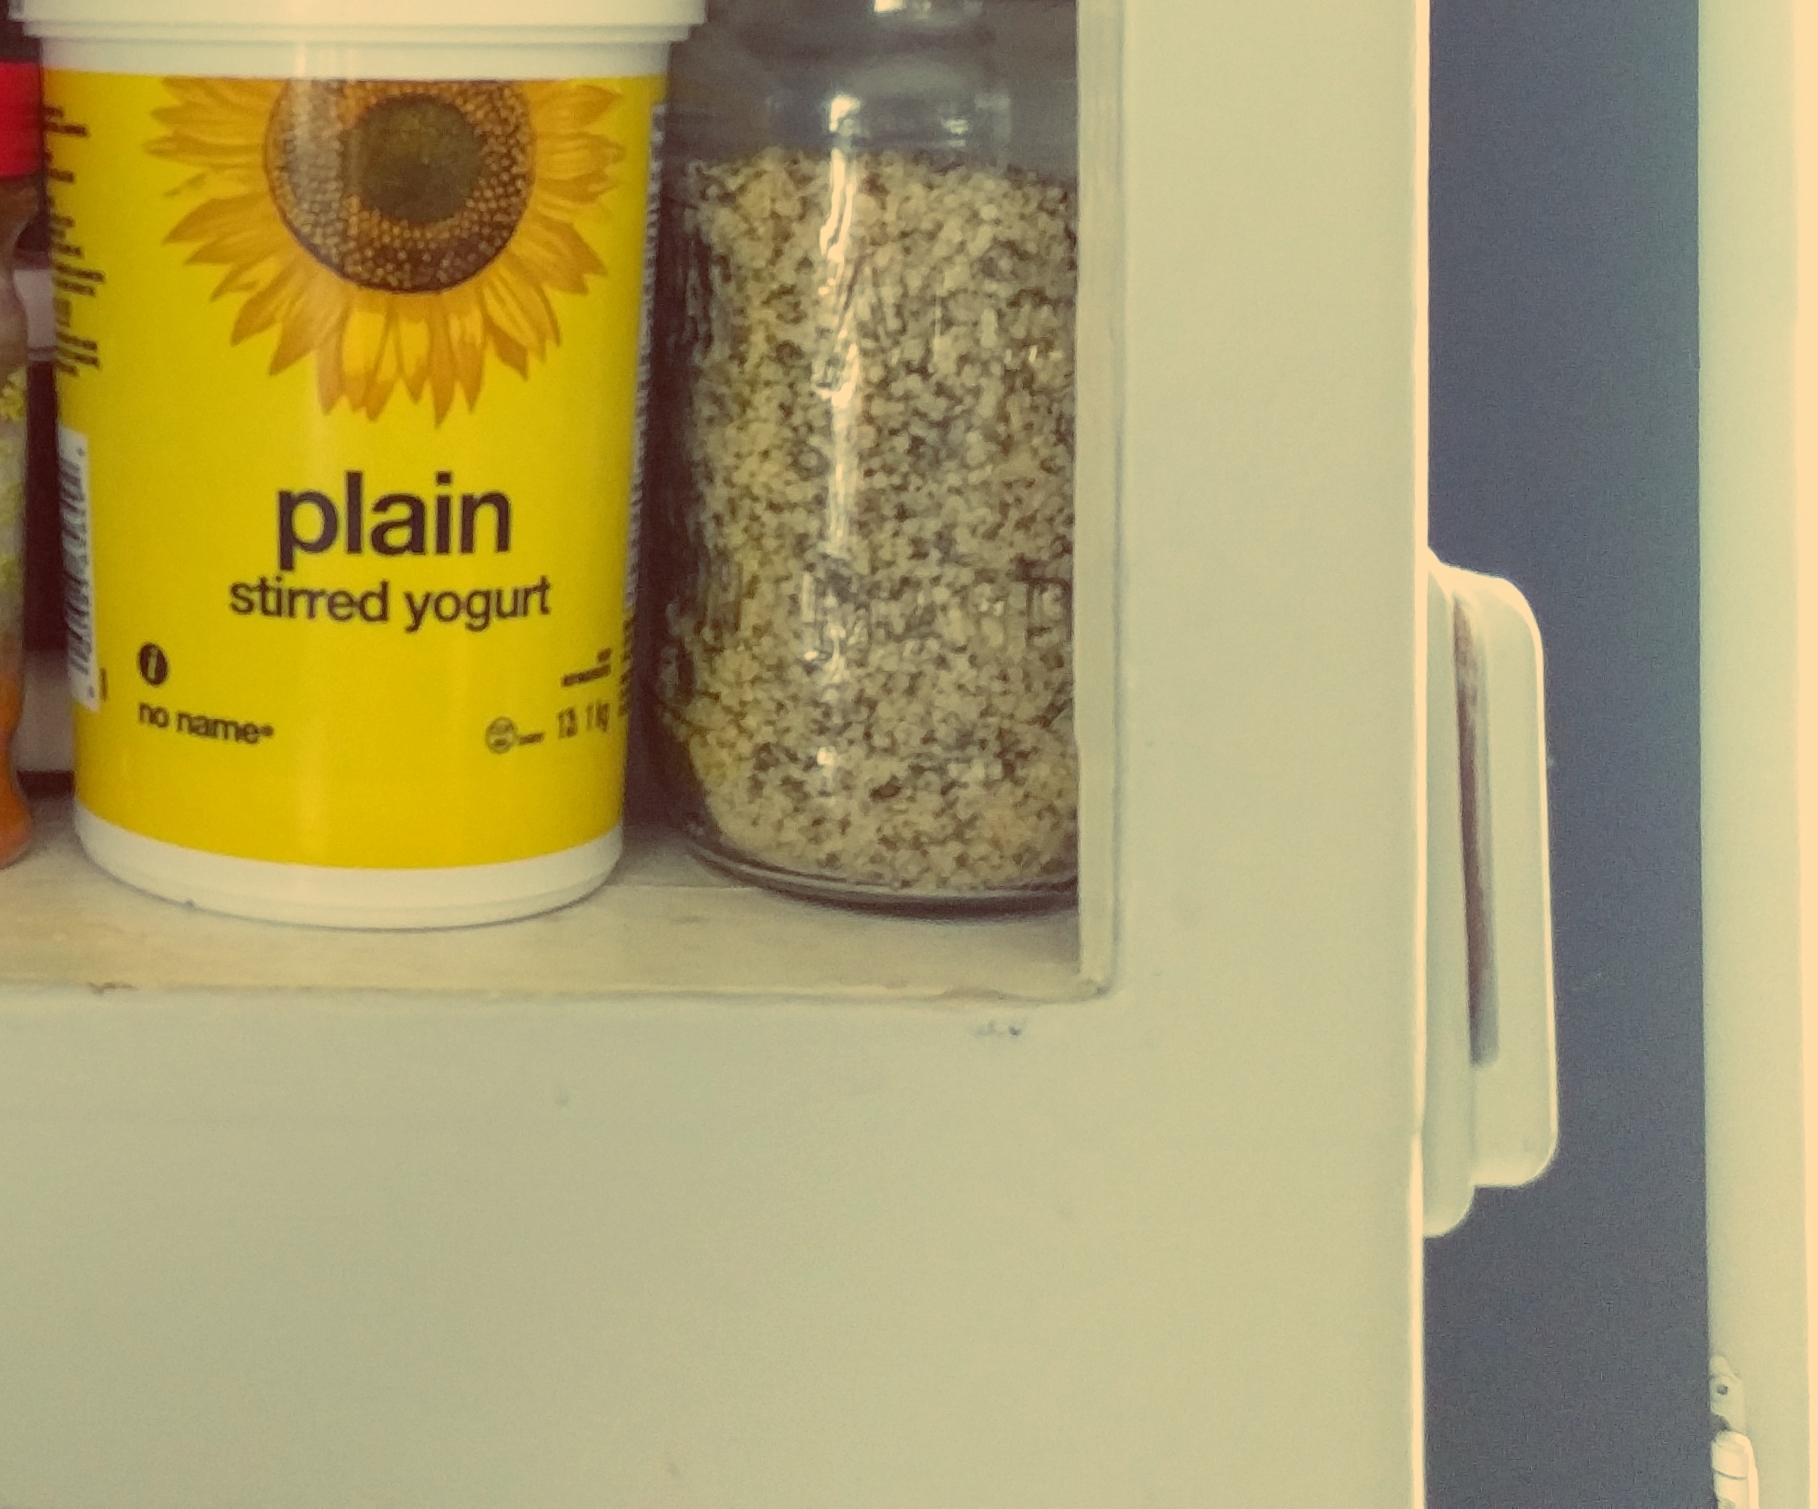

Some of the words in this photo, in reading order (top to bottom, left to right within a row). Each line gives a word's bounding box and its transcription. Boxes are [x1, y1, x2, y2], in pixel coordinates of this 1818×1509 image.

[277, 470, 512, 572] plain
[229, 573, 390, 624] stirred
[403, 576, 551, 634] yogurt
[139, 702, 169, 729] no
